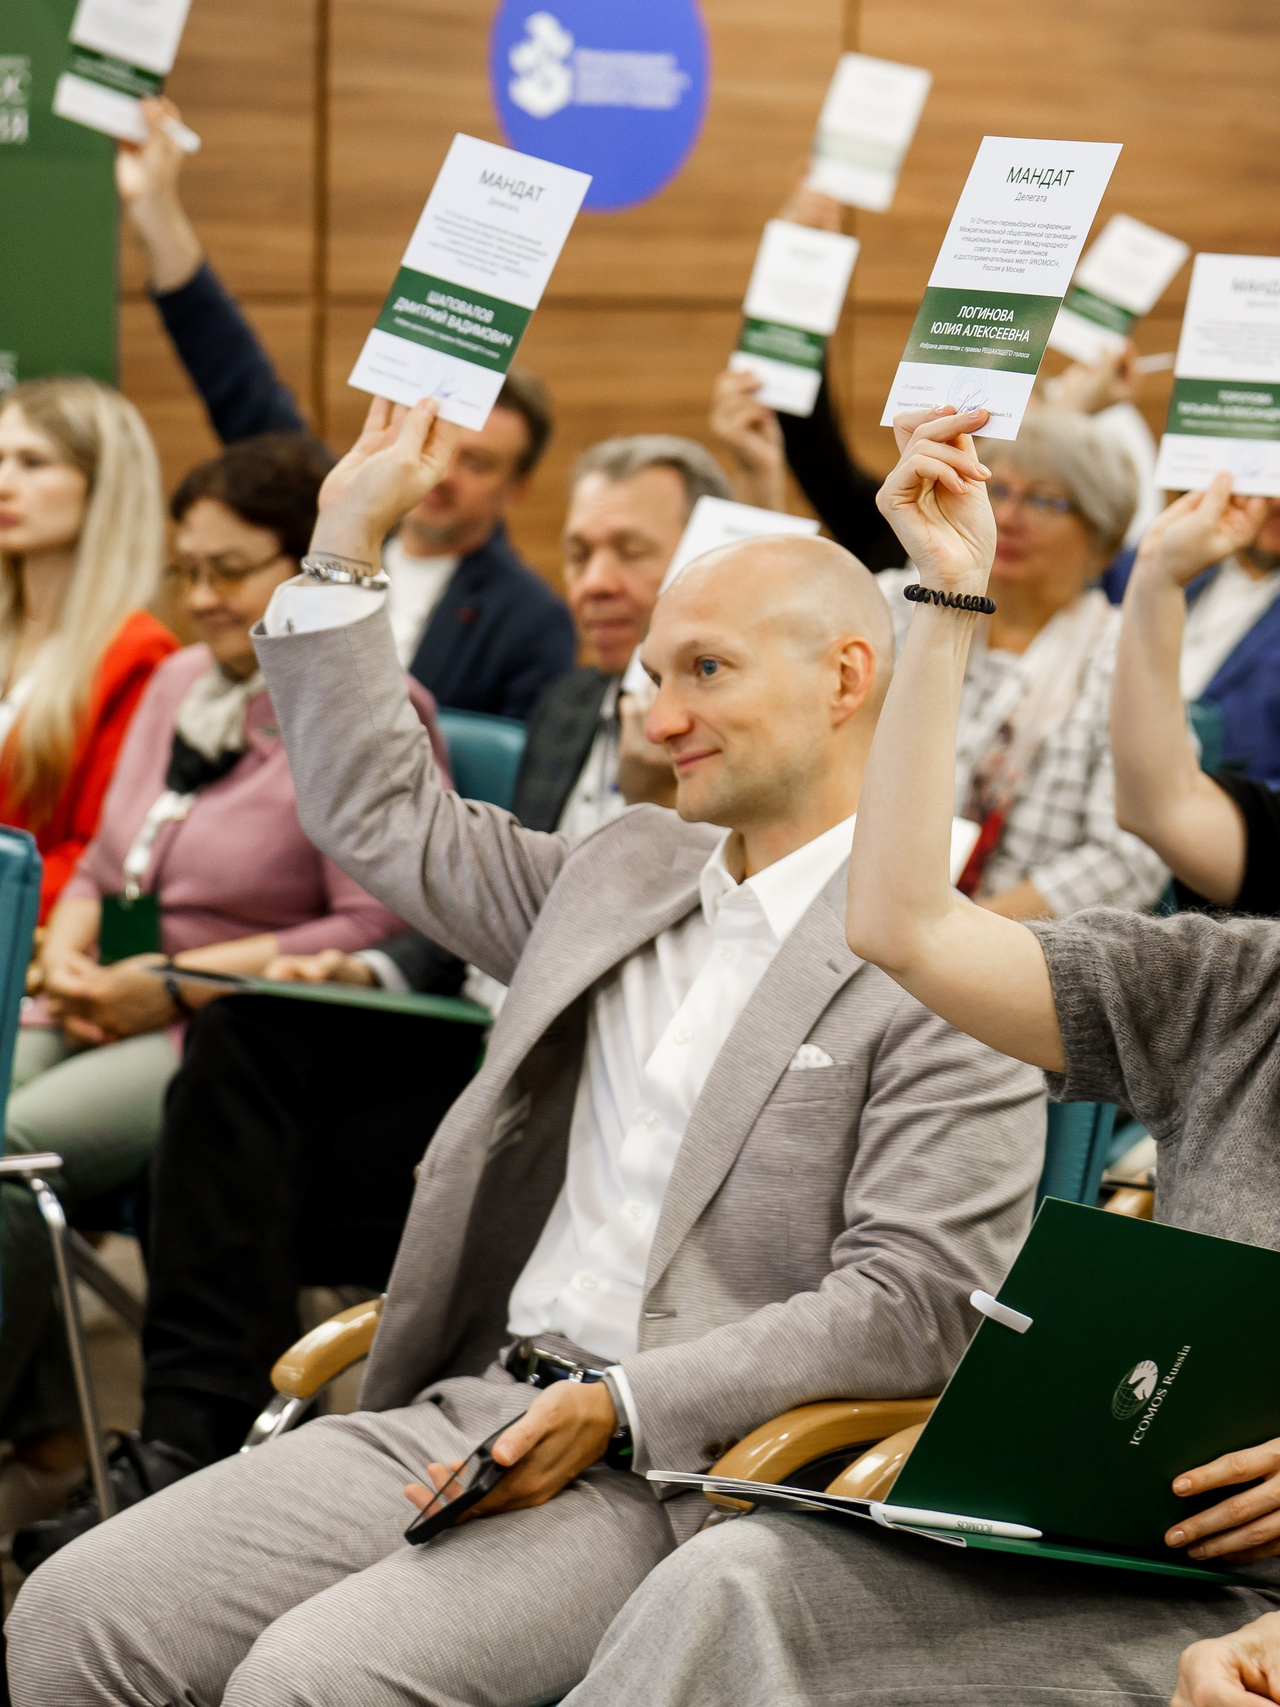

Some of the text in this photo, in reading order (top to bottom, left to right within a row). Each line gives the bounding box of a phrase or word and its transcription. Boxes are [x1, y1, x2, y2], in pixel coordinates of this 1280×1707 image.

[480, 169, 545, 202] МАНДАТ
[1006, 166, 1075, 189] МАНДАТ
[1014, 192, 1048, 203] Делегата
[982, 263, 1001, 272] Россия
[427, 289, 495, 323] ШАПОВАЛОВ
[957, 305, 1015, 322] ЛОГИНОВА
[392, 296, 448, 323] ДМИТРИЙ
[447, 314, 514, 348] ВАДИМОВИЧ
[930, 321, 1030, 342] ЮЛИЯ АЛЕКСЕЕВНА
[1129, 1345, 1191, 1446] ICOMOS Russia
[956, 1520, 993, 1534] ICOMOS
